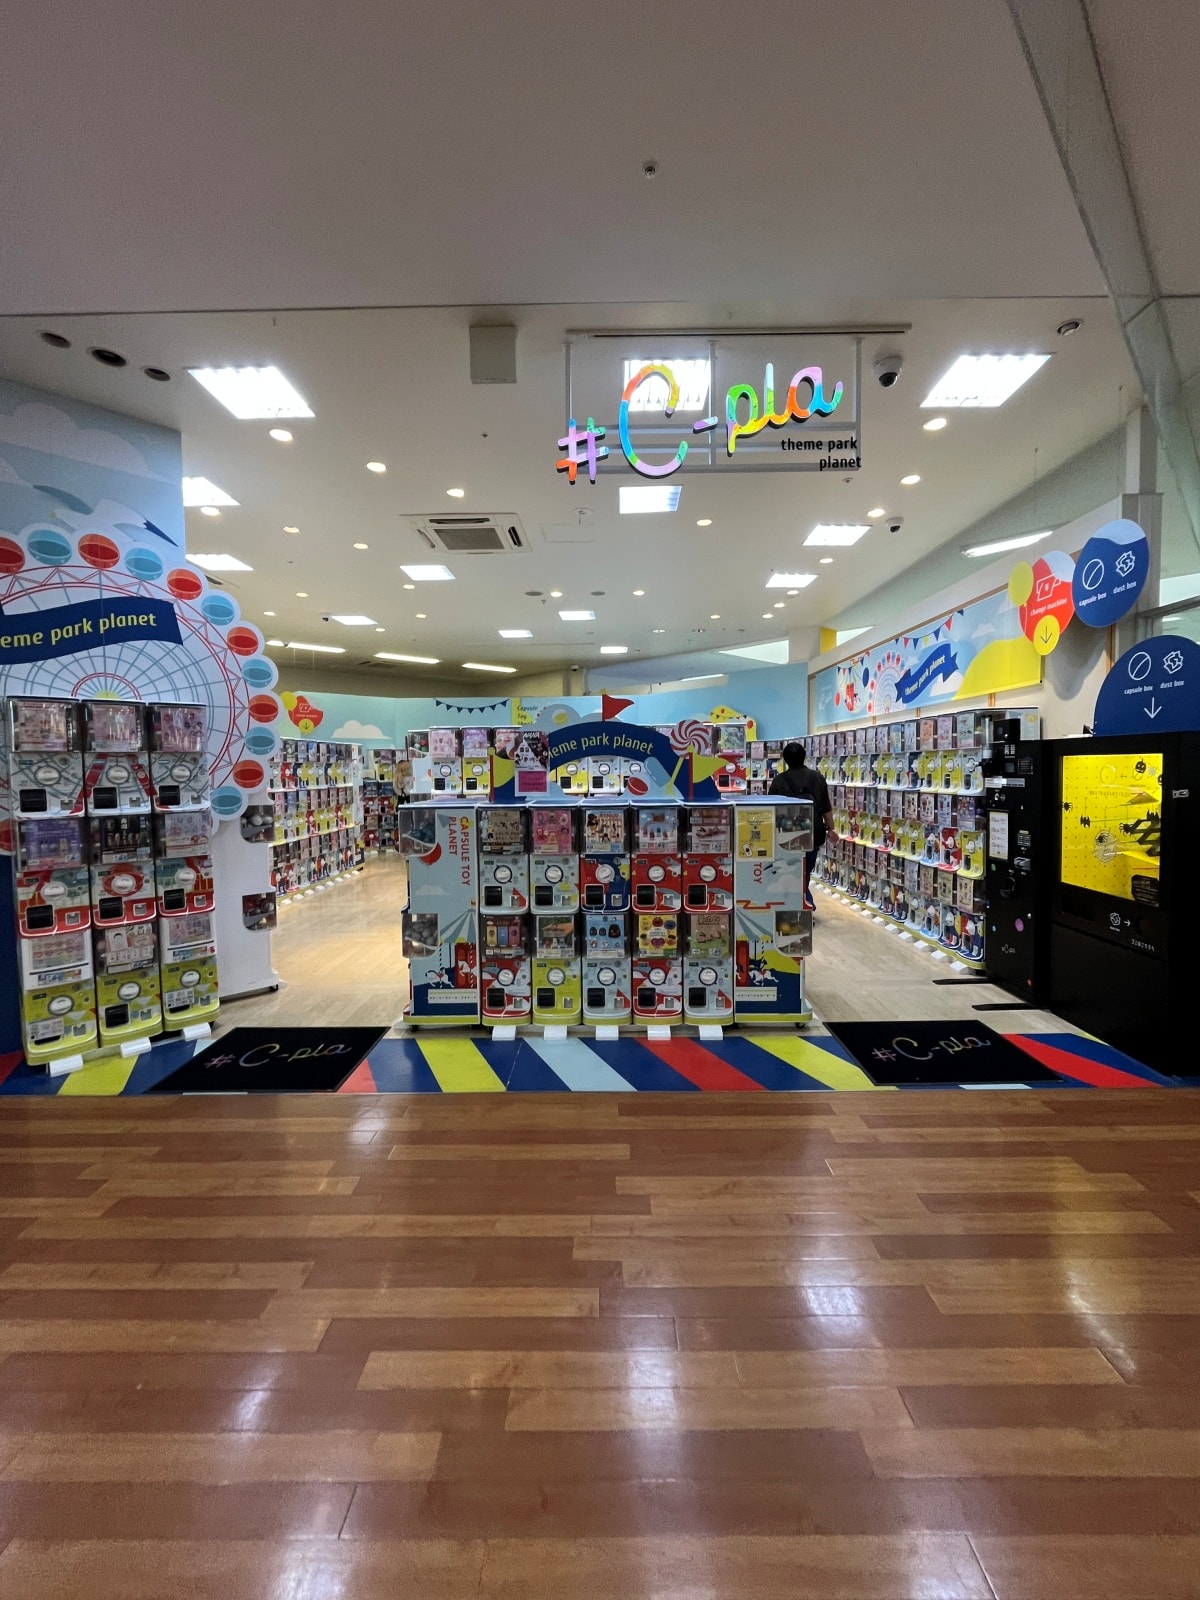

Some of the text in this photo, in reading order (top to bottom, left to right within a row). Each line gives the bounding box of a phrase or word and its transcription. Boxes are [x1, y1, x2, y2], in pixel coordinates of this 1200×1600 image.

[781, 437, 857, 452] theme park
[819, 455, 861, 471] planet
[1097, 592, 1107, 601] box
[1126, 581, 1137, 590] box
[51, 617, 93, 645] park
[99, 613, 157, 634] planet
[581, 733, 609, 751] park
[613, 734, 654, 755] planet
[448, 816, 457, 856] PLANET
[460, 816, 470, 886] CAPSULE TOY
[753, 862, 762, 884] TOY
